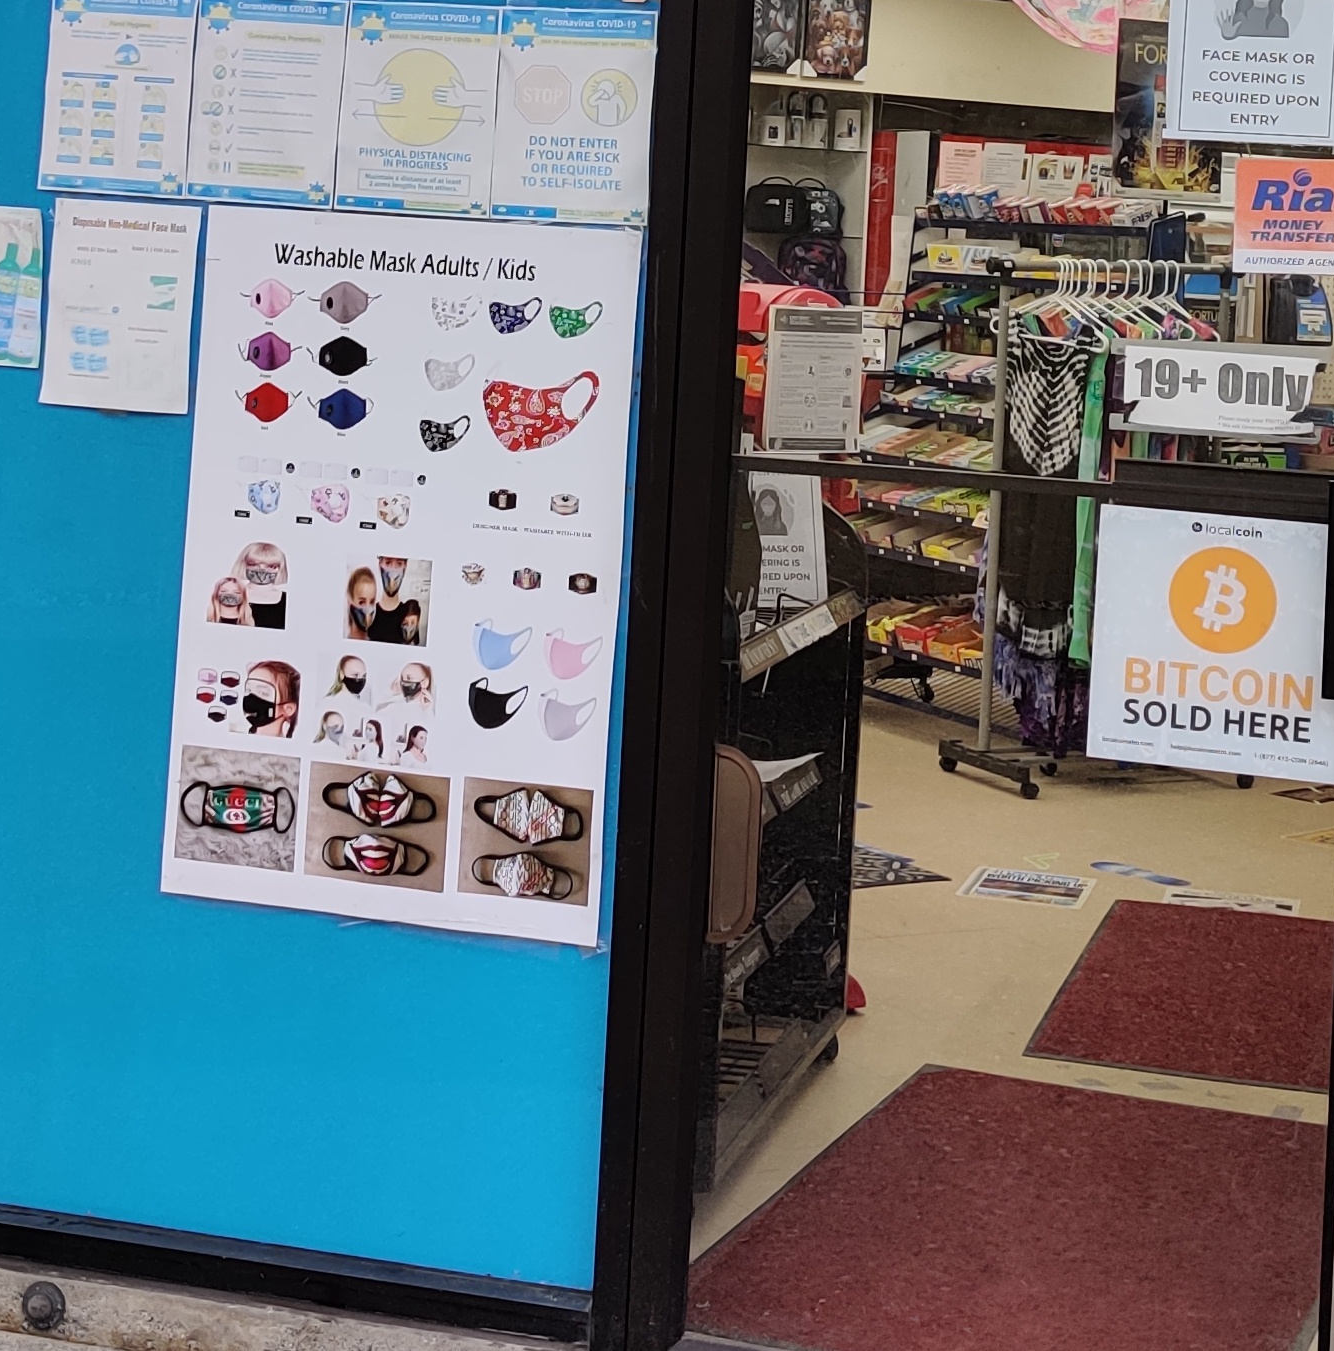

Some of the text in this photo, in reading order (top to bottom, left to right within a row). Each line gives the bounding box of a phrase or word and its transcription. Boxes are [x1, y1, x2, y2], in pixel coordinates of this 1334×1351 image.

[543, 17, 637, 29] Coronavirus COVID-19
[1202, 50, 1315, 64] FACE MASK OR
[1209, 71, 1306, 85] COVERING IS
[524, 86, 564, 104] STOP
[1192, 91, 1320, 106] REQUIRED UPON
[1230, 114, 1280, 126] ENTRY
[529, 136, 618, 149] DO NOT ENTER
[359, 147, 472, 162] PHYSICAL DISTANCING
[525, 149, 620, 163] IF YOU ARE SICK
[383, 159, 448, 171] IN PROGRESS
[531, 164, 613, 177] OR REQUIRED
[522, 176, 622, 191] TO SELF-ISOLATE
[1251, 168, 1334, 212] Ria
[1263, 219, 1324, 230] MONEY
[276, 244, 537, 282] Washable Mask Adults / Kids
[1244, 256, 1305, 266] AUTHORIZED
[1134, 358, 1309, 411] 19+ Only
[1206, 522, 1263, 538] localcoin
[791, 545, 804, 553] OR
[792, 559, 800, 567] IS
[784, 573, 810, 581] UPON
[1124, 657, 1314, 712] BITCOIN
[1123, 698, 1312, 743] SOLD HERE
[213, 796, 260, 808] GUCCI
